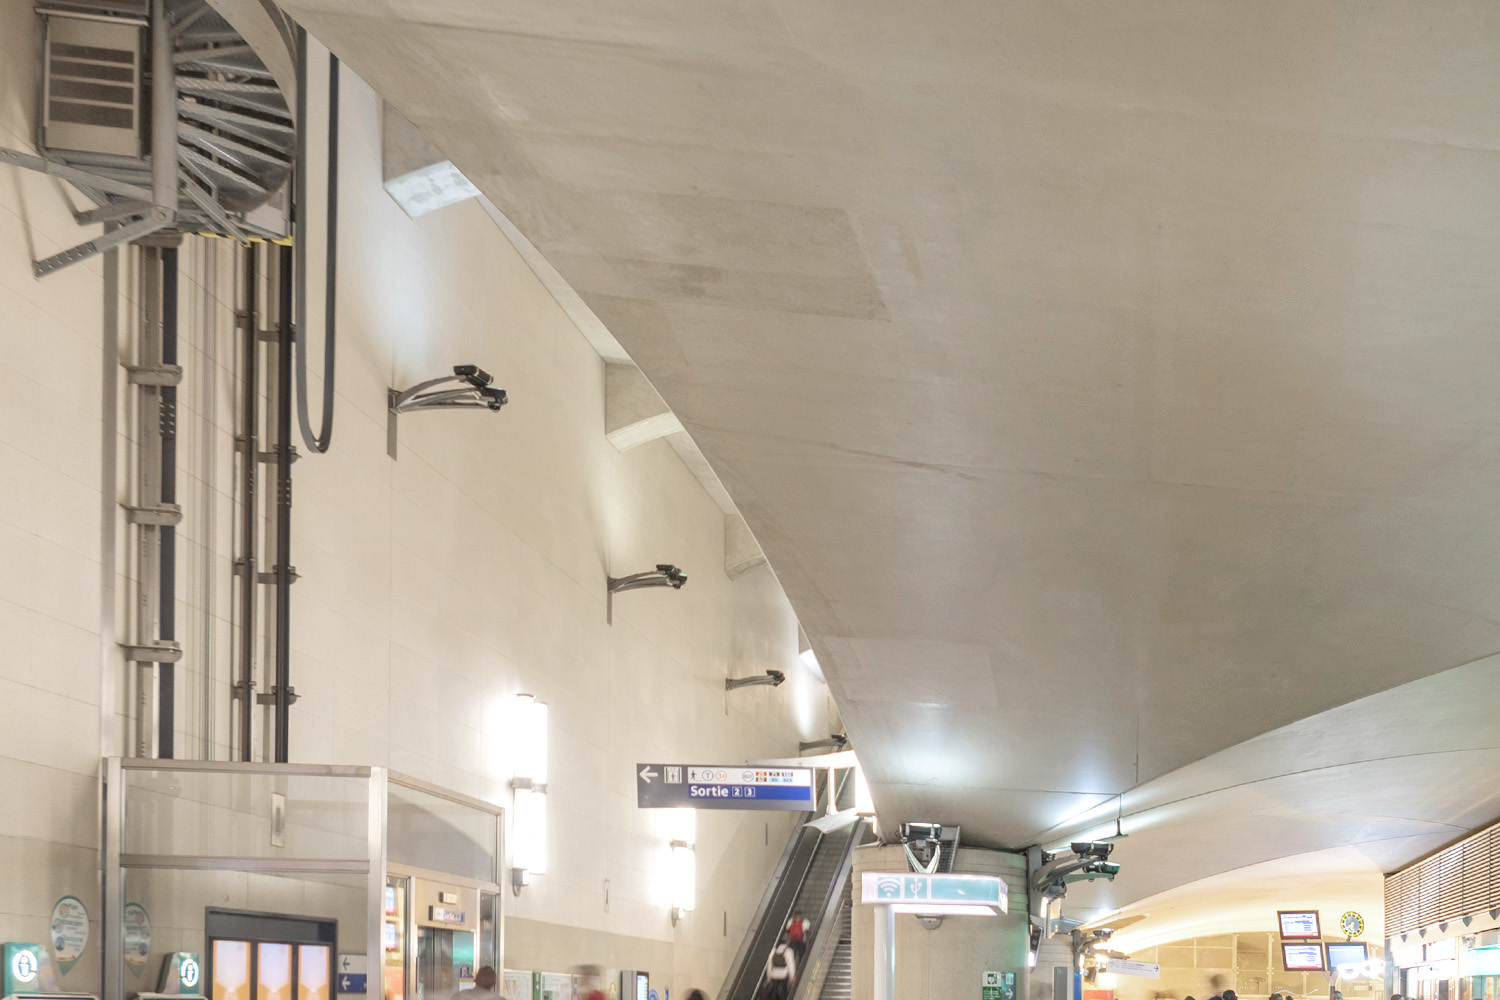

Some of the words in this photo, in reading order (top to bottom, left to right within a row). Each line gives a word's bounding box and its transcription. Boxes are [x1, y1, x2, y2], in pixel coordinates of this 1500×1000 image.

[690, 785, 729, 797] Sortie
[734, 788, 740, 796] 2
[747, 788, 752, 796] 3
